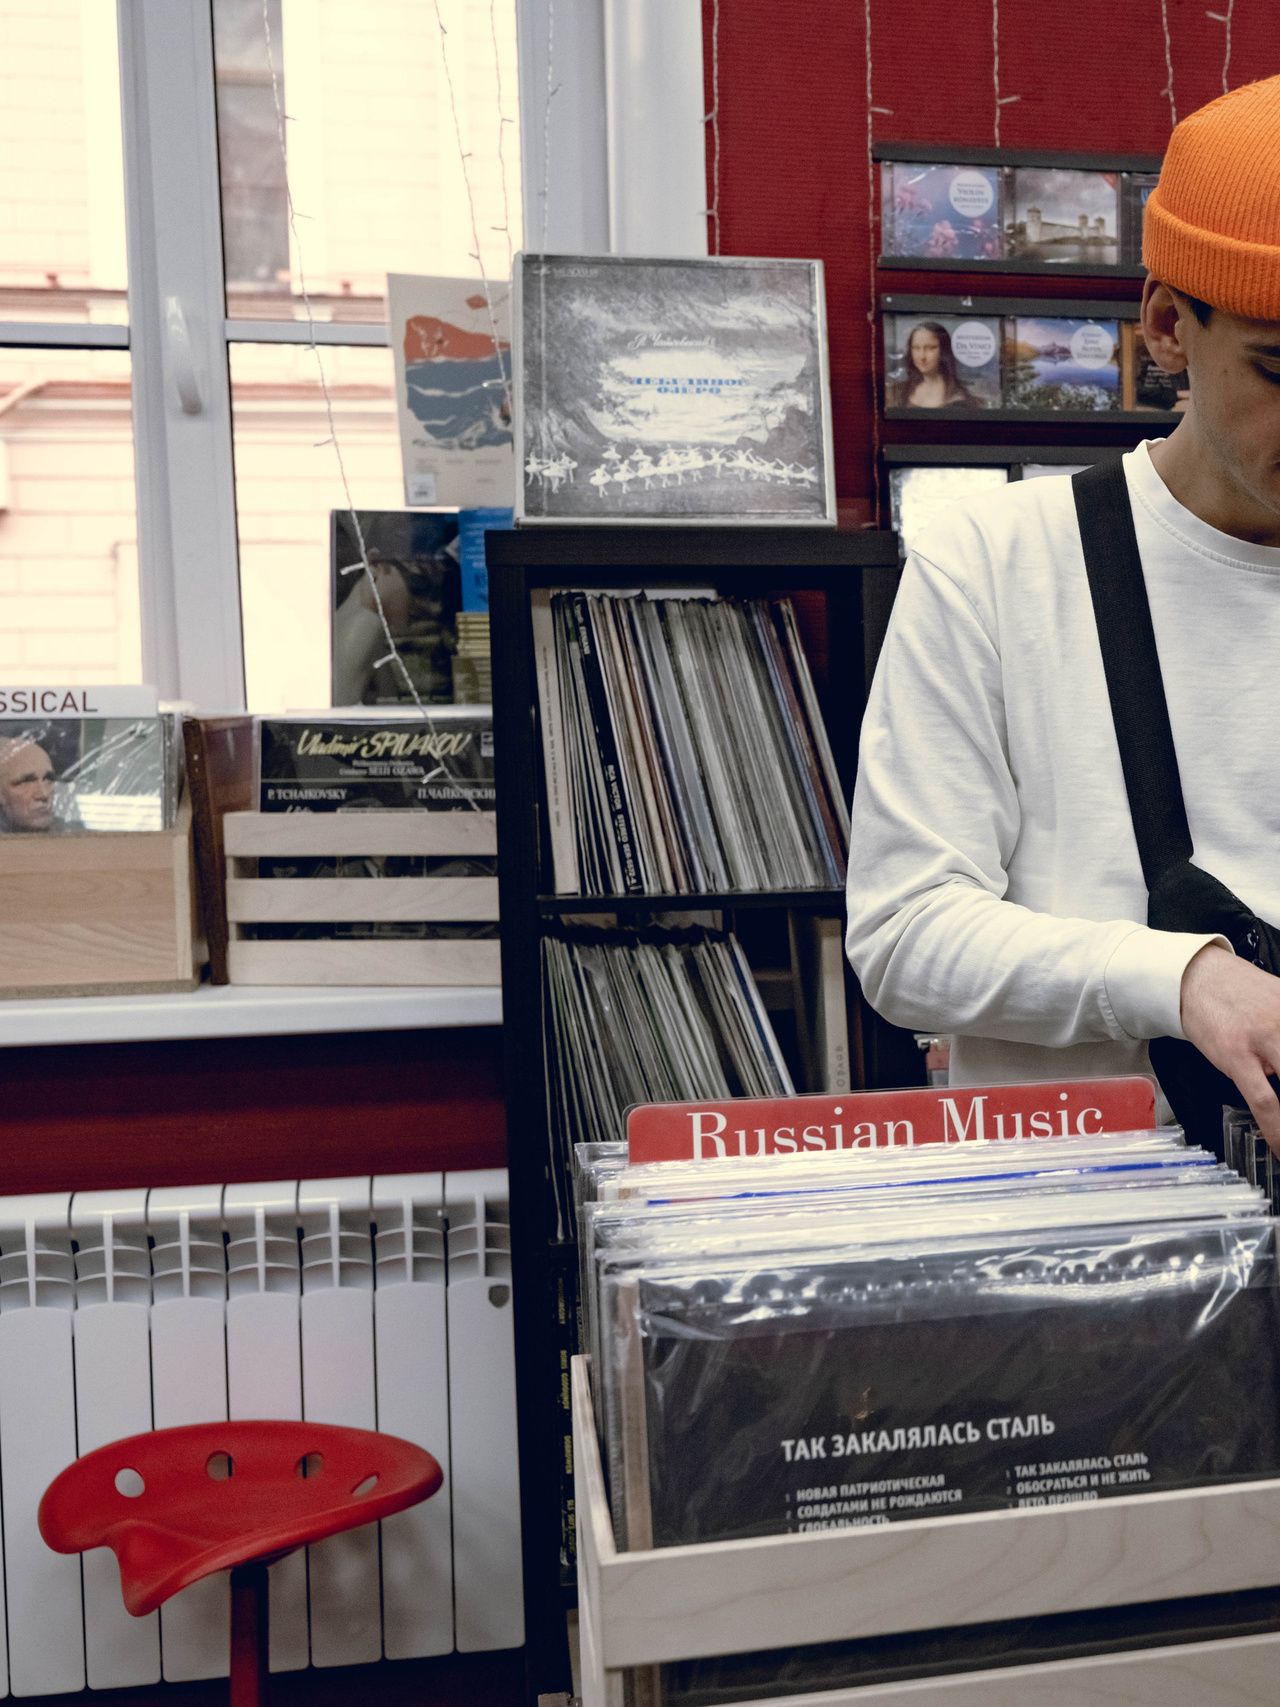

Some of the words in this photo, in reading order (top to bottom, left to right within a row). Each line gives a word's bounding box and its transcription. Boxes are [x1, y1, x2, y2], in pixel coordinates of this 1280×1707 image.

[297, 729, 366, 757] Vladimir
[360, 730, 473, 759] SPIVAKOV
[392, 766, 425, 776] OZAWA
[276, 788, 347, 800] TCHAIKOVSKY
[610, 782, 622, 810] VICTOR
[616, 813, 628, 842] STEREO
[686, 1106, 914, 1161] Russian
[938, 1092, 1104, 1145] Music
[781, 1436, 826, 1462] ТАК
[831, 1422, 981, 1459] ЗАКАЛЯЛАСЬ
[986, 1414, 1056, 1443] СТАЛЬ
[1014, 1463, 1037, 1478] ТАК
[1039, 1456, 1112, 1475] ЗАКАЛЯЛАСЬ
[1113, 1452, 1148, 1467] СТАЛЬ
[796, 1485, 838, 1502] НОВАЯ
[840, 1474, 946, 1496] ПАТРИОТИЧЕСКАЯ
[1016, 1475, 1088, 1495] ОБОСРАТЬСЯ
[1090, 1473, 1099, 1486] И
[1101, 1472, 1117, 1485] НЕ
[1118, 1468, 1151, 1484] ЖИТЬ
[797, 1499, 869, 1519] СОЛДАТАМИ
[871, 1497, 888, 1510] НЕ
[889, 1489, 962, 1508] РОЖДАЮТСЯ
